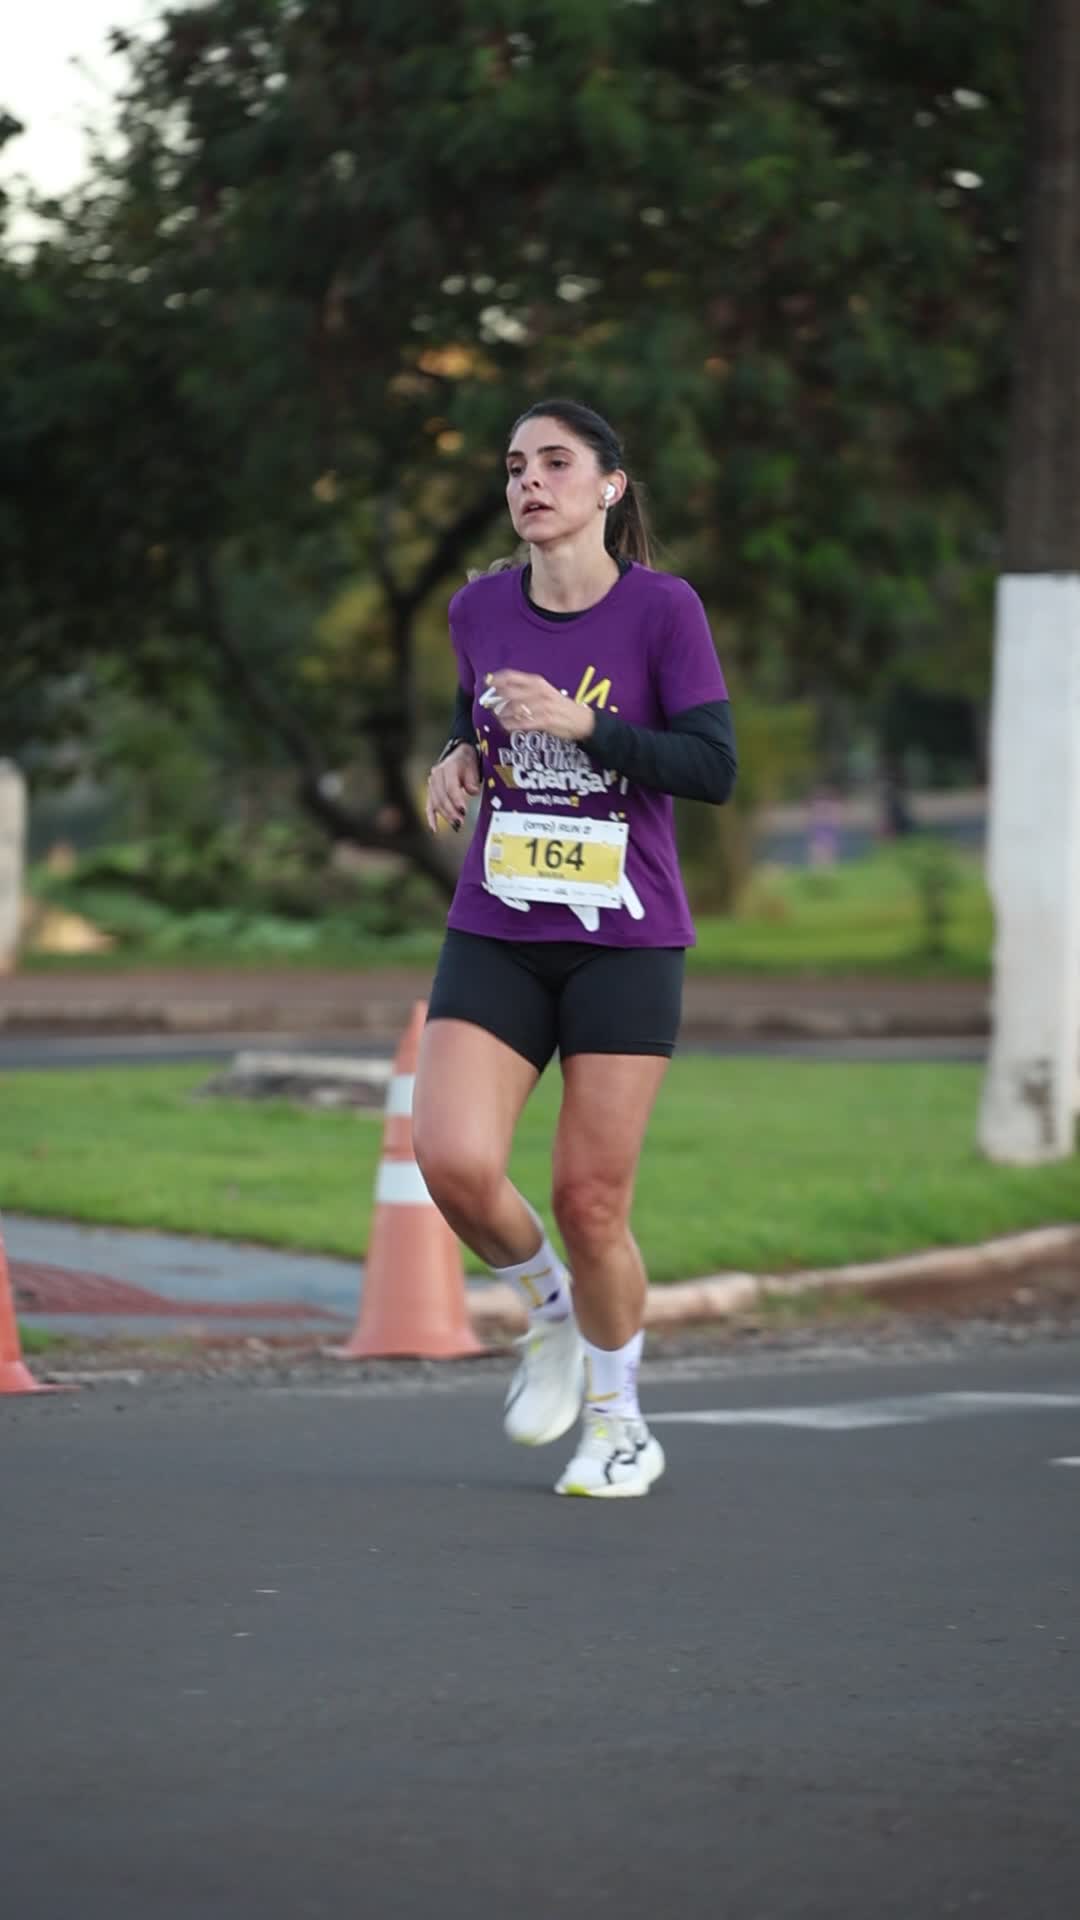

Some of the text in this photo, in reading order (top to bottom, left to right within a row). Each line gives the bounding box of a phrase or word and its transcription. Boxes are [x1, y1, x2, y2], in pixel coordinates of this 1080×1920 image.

[498, 747, 541, 769] POR
[512, 763, 608, 796] Criança
[559, 823, 581, 833] RUN
[525, 837, 585, 871] 164
